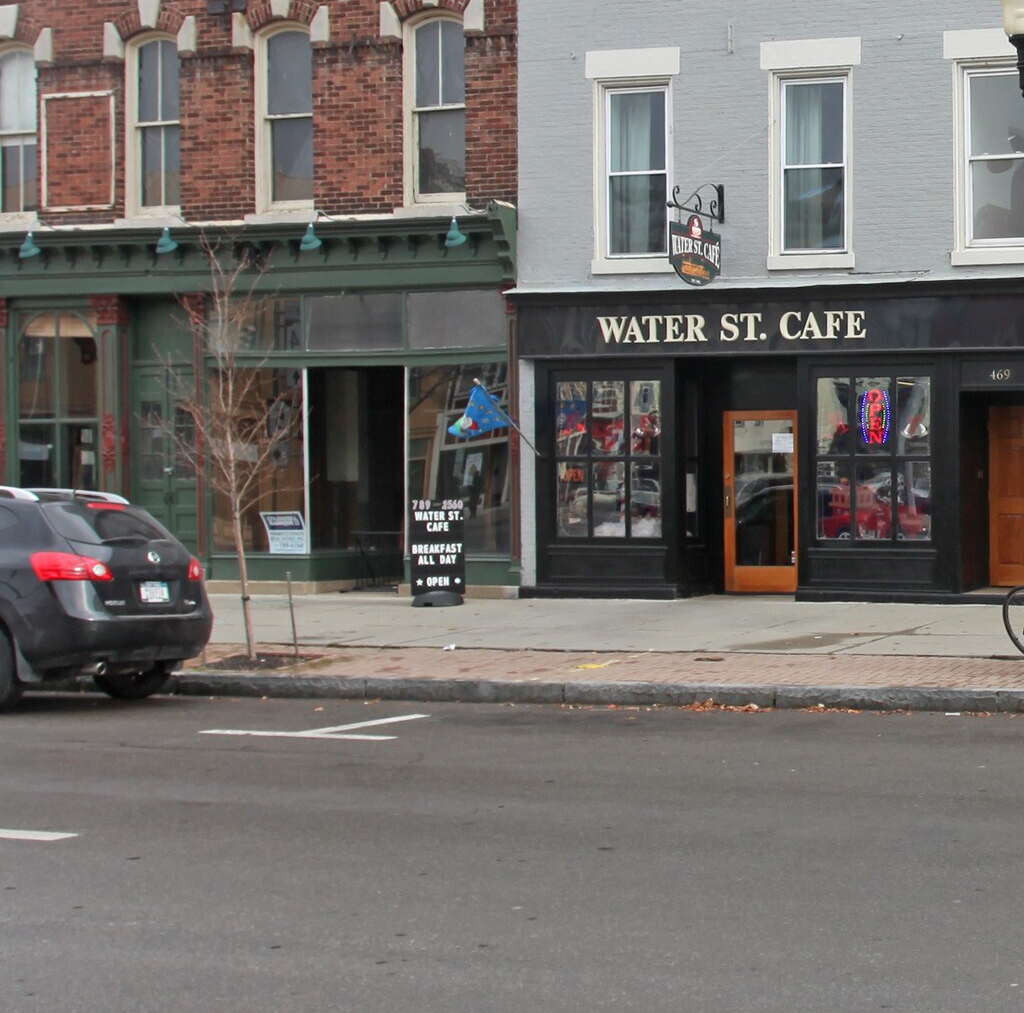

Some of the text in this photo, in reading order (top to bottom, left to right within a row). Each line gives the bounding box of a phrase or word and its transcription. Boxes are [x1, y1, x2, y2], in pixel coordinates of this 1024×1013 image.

[671, 234, 720, 270] WATER ST. CAFÉ
[596, 310, 867, 344] WATER ST. CAFE
[990, 369, 1010, 380] 469
[867, 389, 884, 444] OPEN
[414, 510, 464, 521] WATER ST.
[426, 522, 449, 532] CAFE
[412, 543, 462, 554] BREAKFAST
[418, 555, 457, 565] ALL DAY
[426, 576, 450, 586] OPEN
